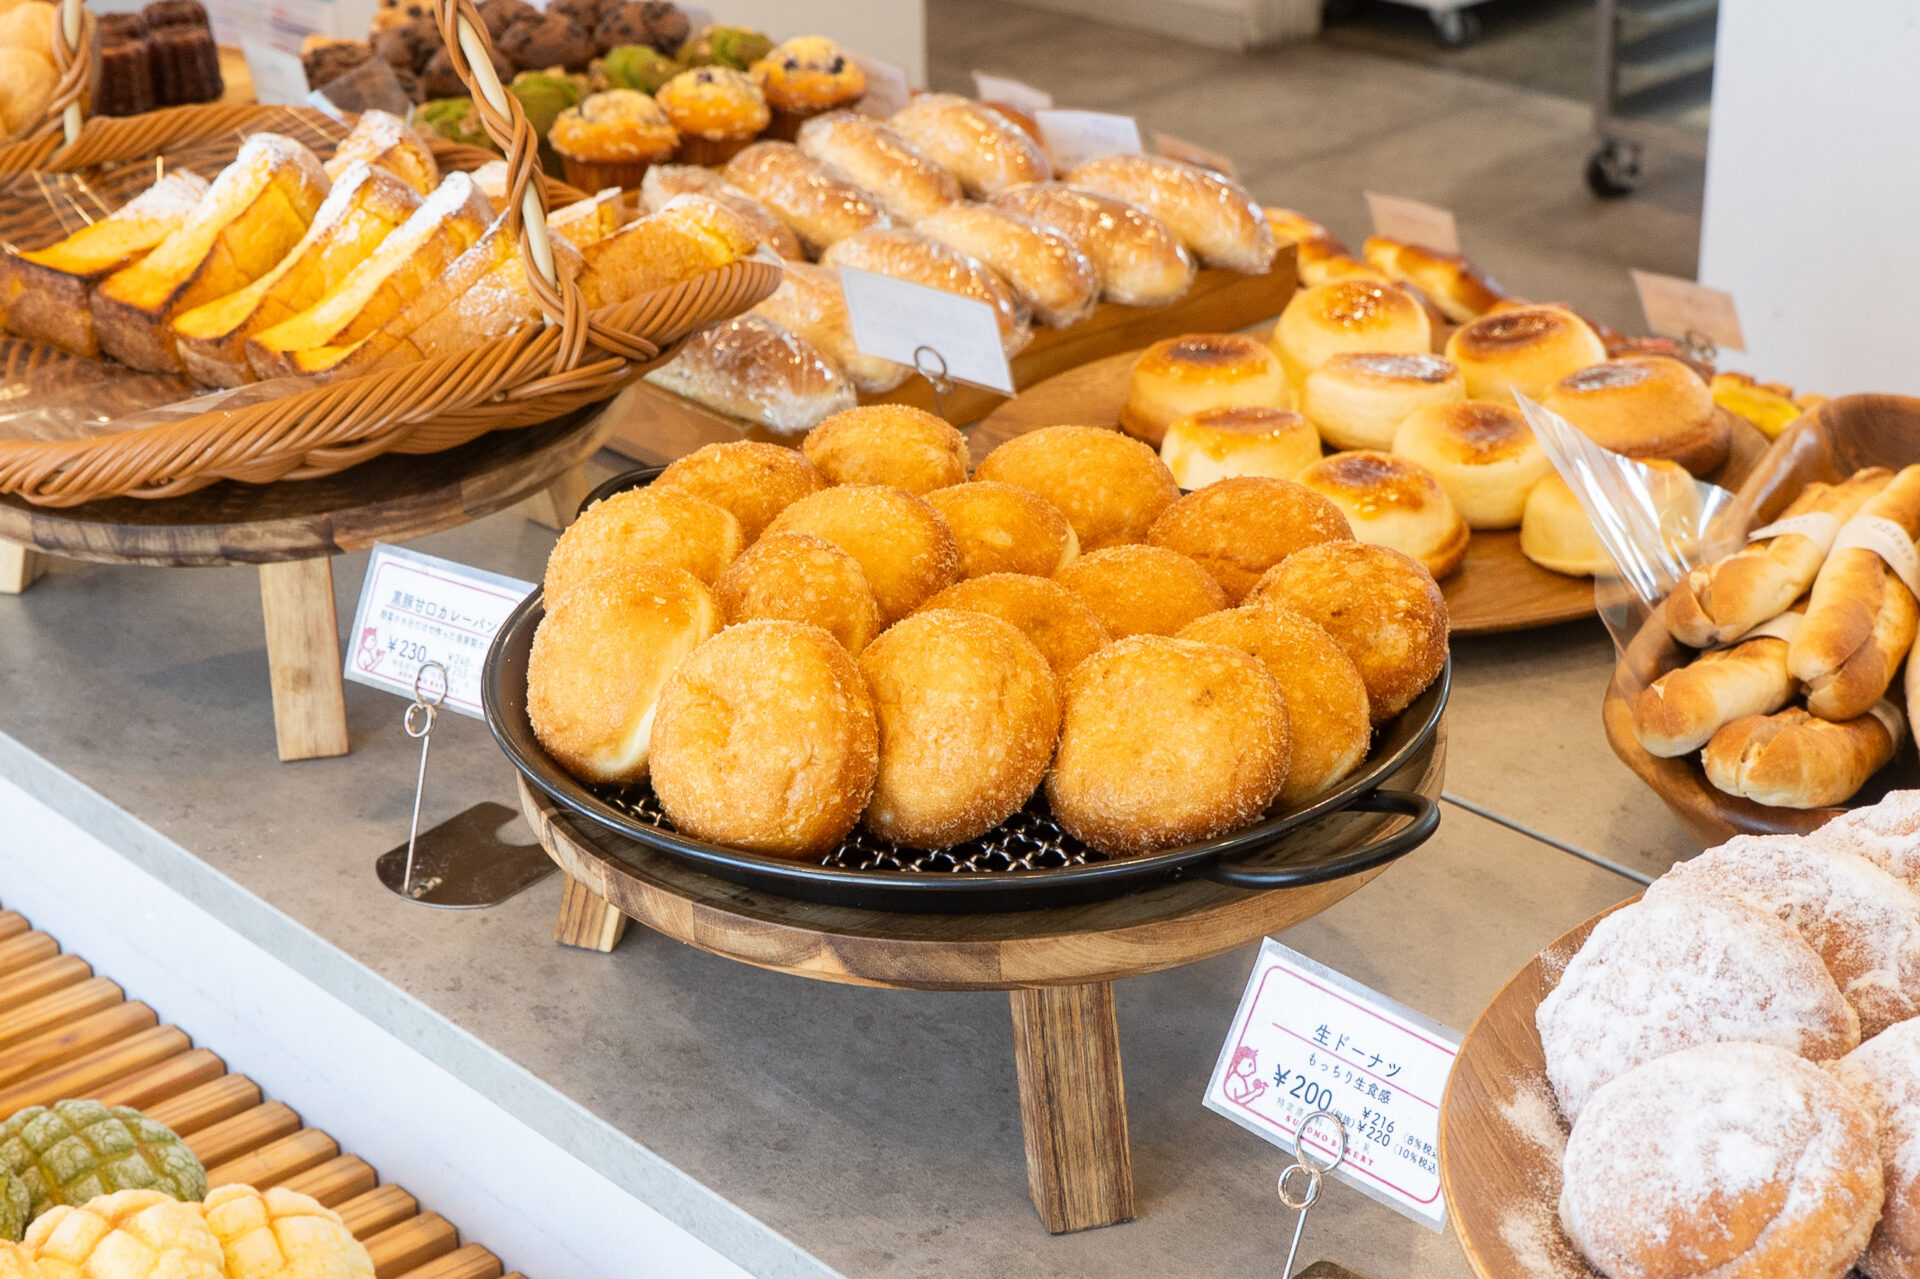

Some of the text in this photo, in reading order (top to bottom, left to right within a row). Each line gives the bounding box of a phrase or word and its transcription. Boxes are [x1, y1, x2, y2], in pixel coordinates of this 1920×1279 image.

[388, 635, 427, 663] ¥230
[1312, 1023, 1403, 1078] 生ドーナツ
[1273, 1063, 1333, 1111] ¥200
[1307, 1052, 1393, 1104] もっちり生食感
[1285, 1115, 1375, 1166] SUOMO BKERY
[1357, 1120, 1391, 1147] ¥220
[1362, 1106, 1395, 1133] ¥216
